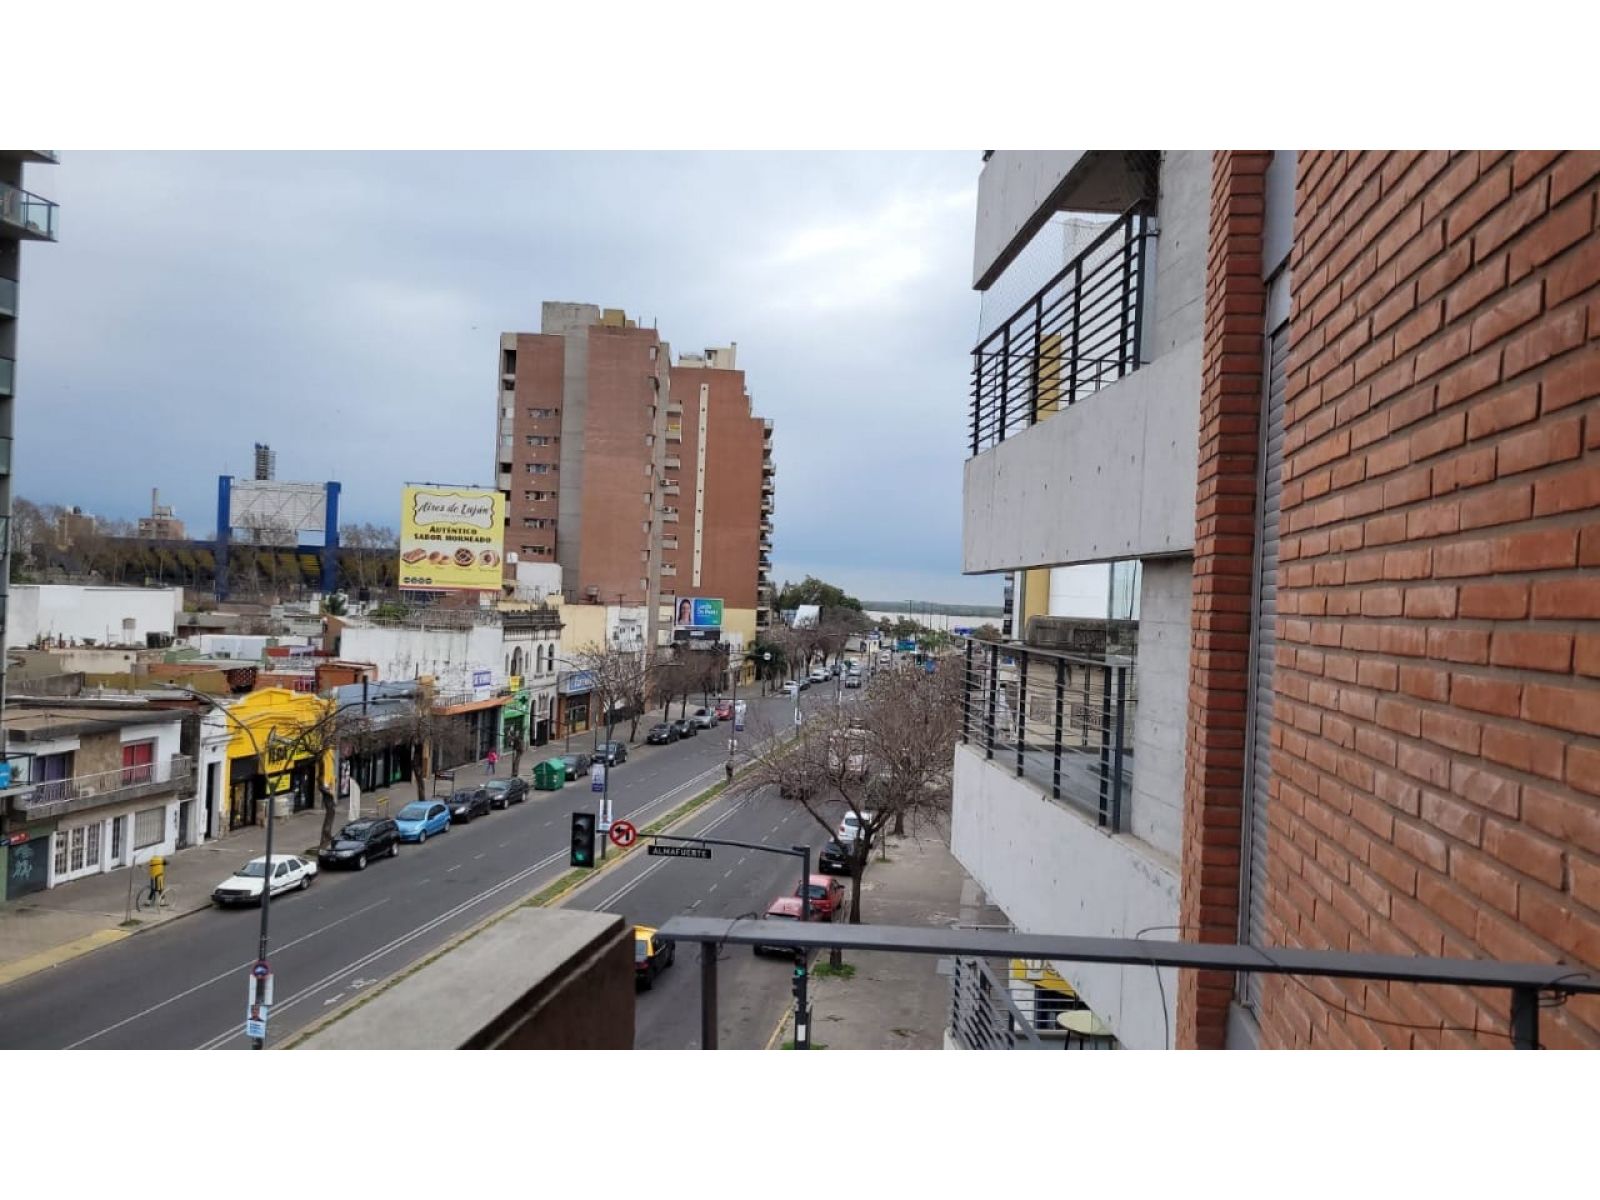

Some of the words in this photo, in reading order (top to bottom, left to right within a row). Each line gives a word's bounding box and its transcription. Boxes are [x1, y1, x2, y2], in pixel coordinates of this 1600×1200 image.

[418, 501, 445, 513] Aires
[446, 502, 458, 513] de
[414, 533, 441, 541] SABOR
[445, 535, 492, 543] HORNEADO
[652, 847, 708, 858] ALMAFUERTE
